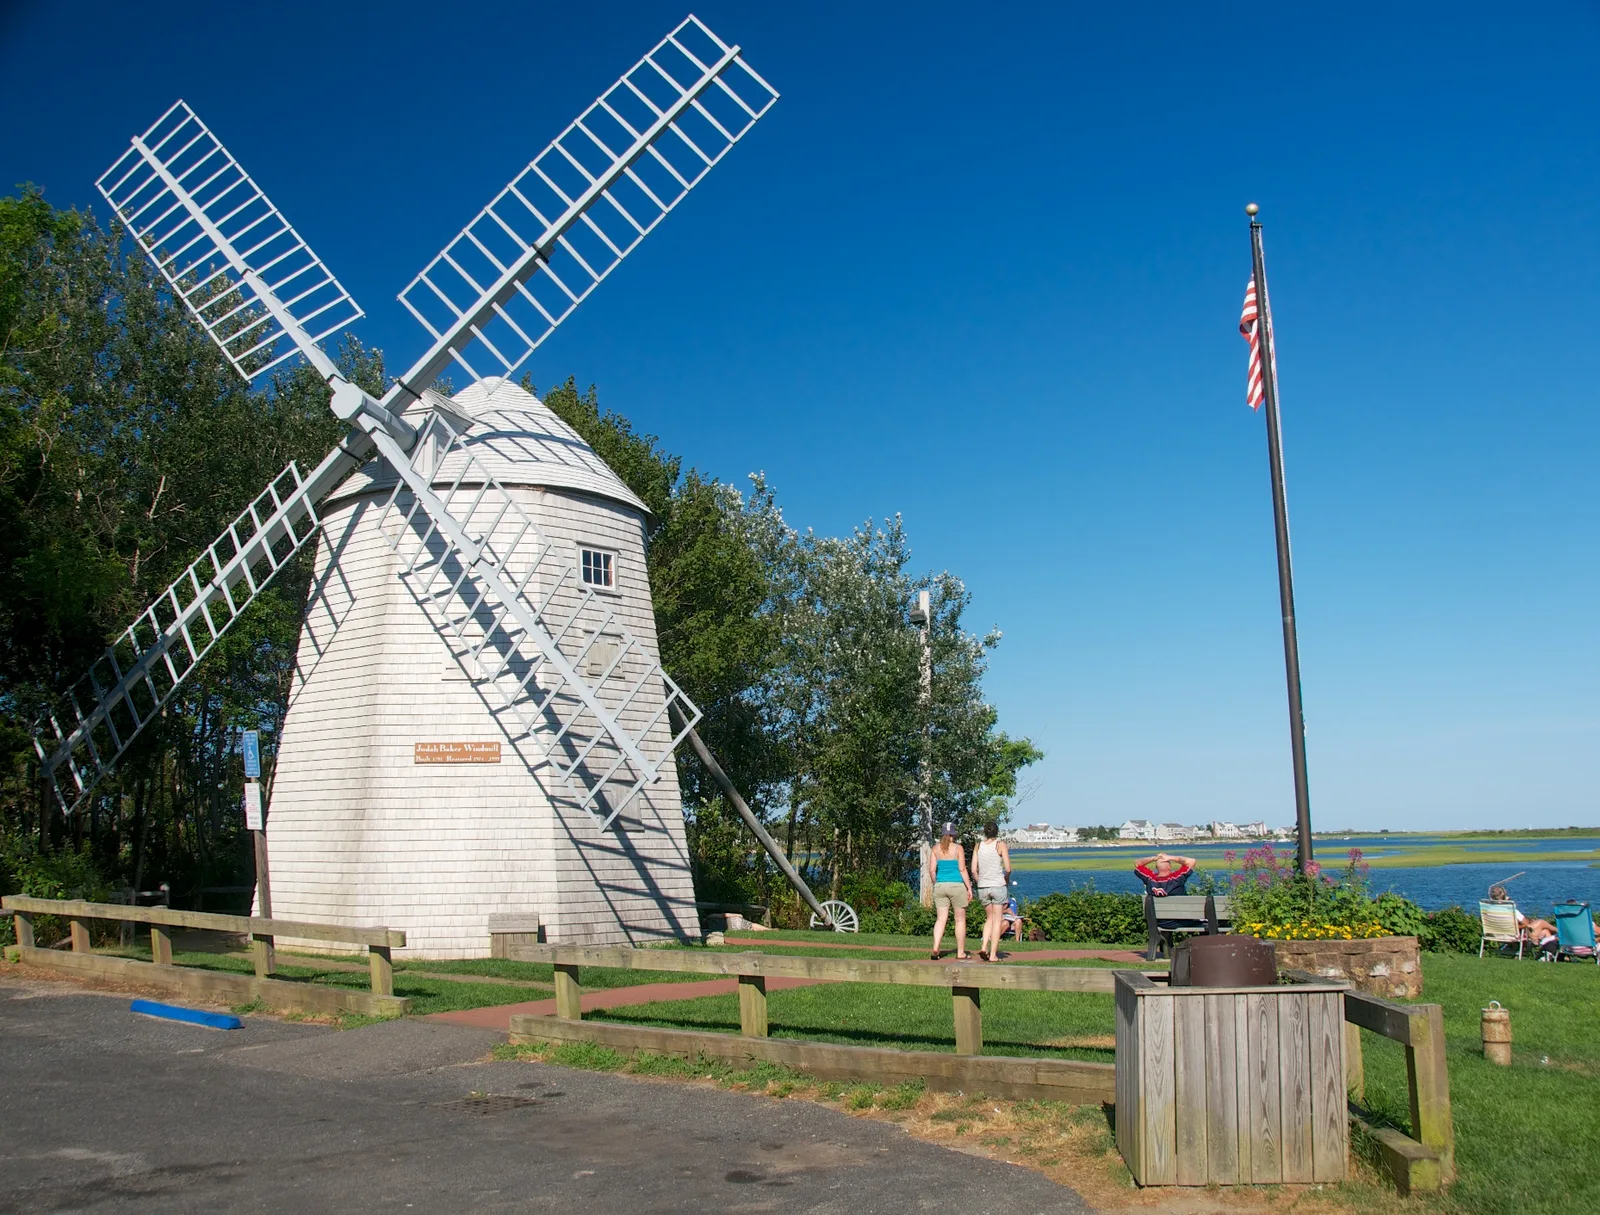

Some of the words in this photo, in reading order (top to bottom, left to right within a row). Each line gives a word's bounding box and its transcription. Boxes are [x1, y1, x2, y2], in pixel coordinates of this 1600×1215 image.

[416, 744, 439, 752] Judah
[440, 744, 462, 752] Baker
[463, 744, 499, 752] Windmill
